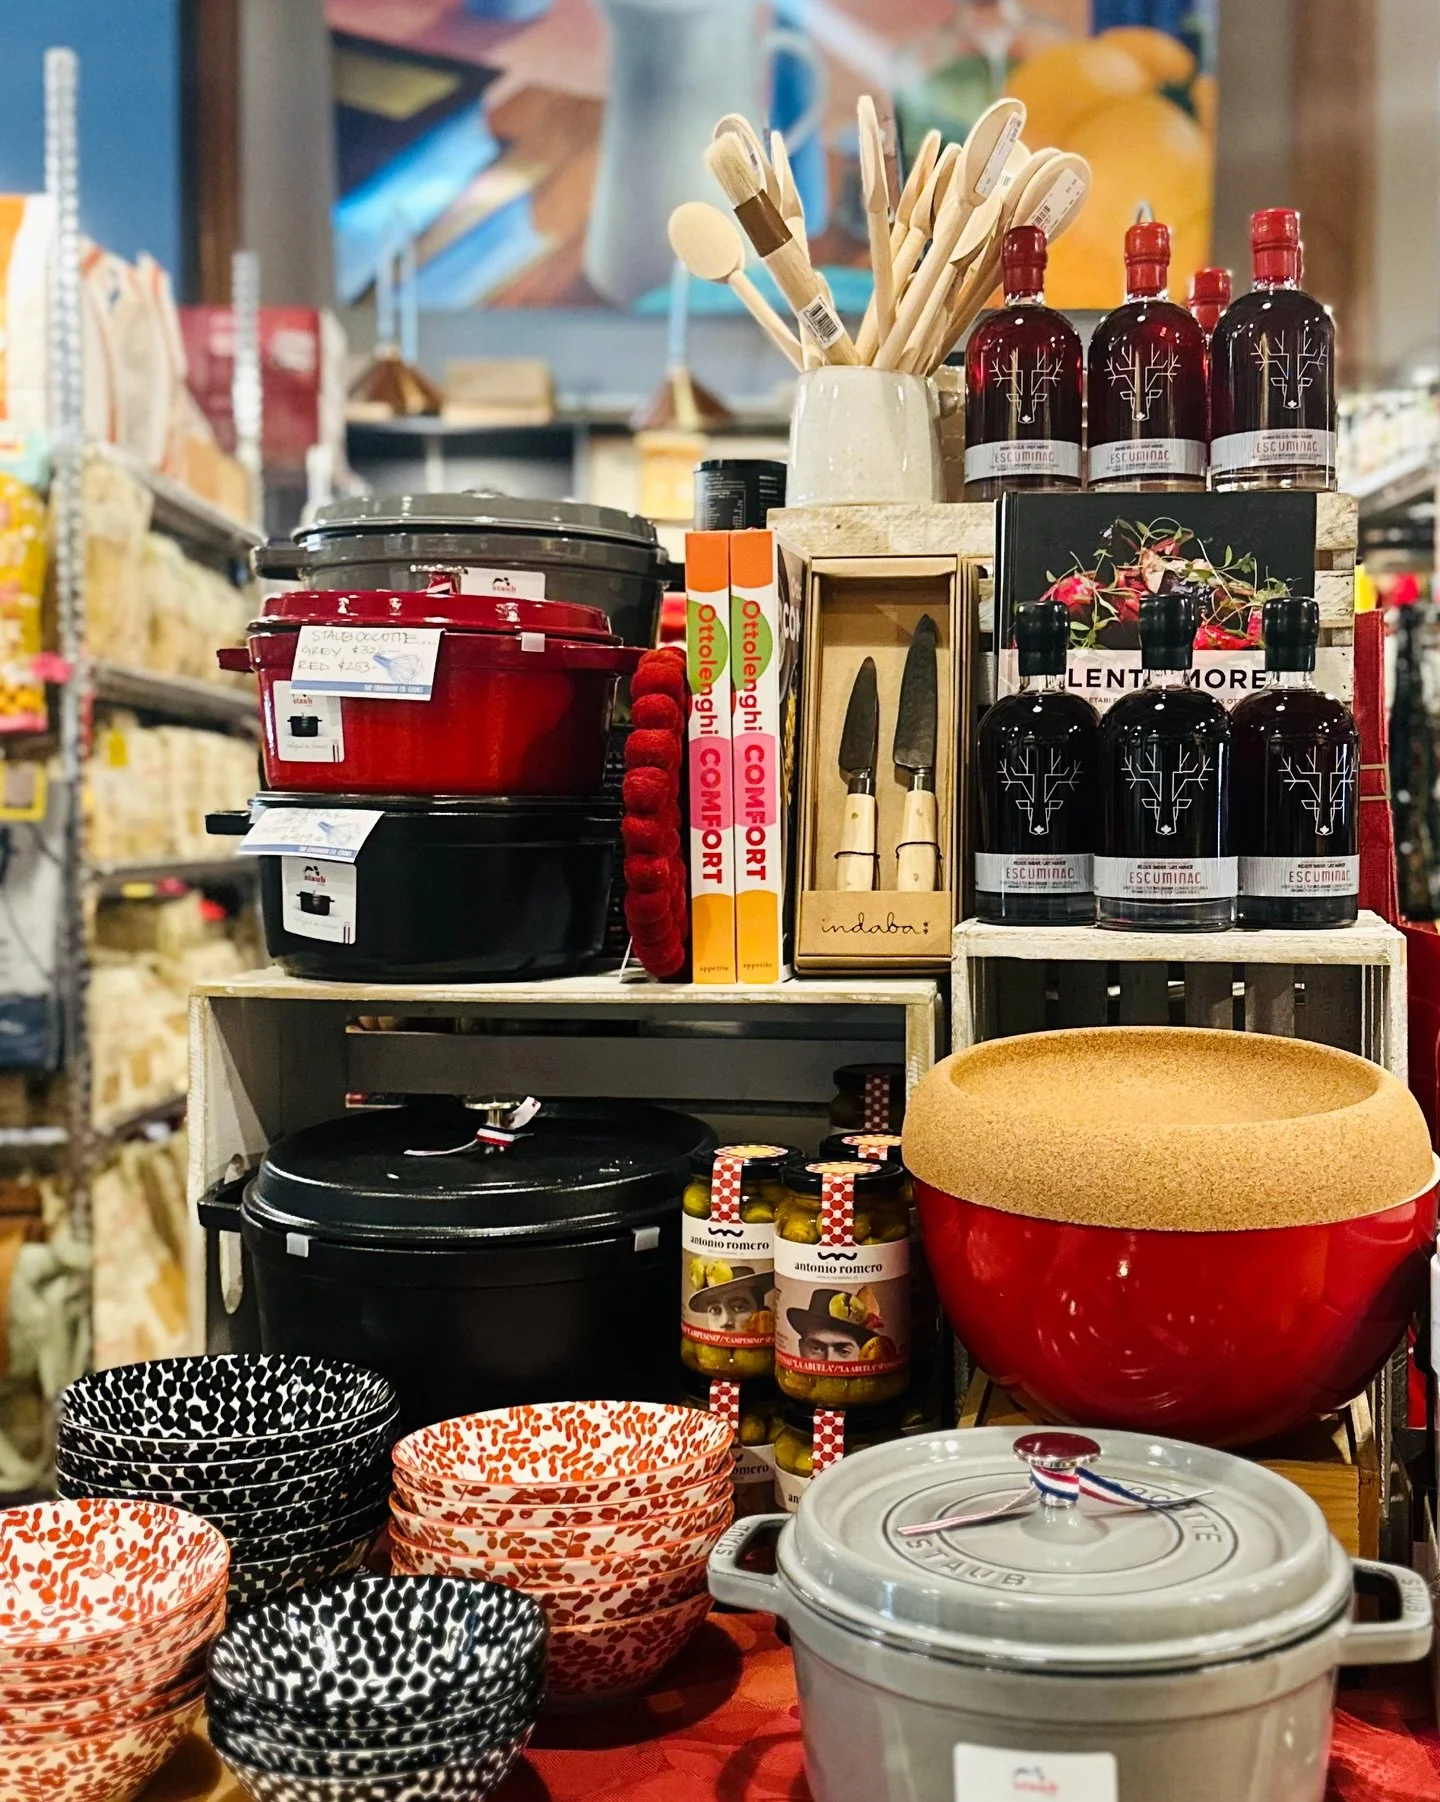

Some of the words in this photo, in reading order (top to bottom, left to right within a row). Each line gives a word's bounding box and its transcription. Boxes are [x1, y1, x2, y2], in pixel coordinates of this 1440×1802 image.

[695, 604, 718, 734] Ottolenghi
[739, 600, 763, 731] Ottolenghi
[1068, 668, 1143, 688] LENT
[700, 748, 722, 884] COMFORT
[744, 744, 766, 880] COMFORT
[1006, 867, 1074, 879] ESCUMINAC
[1129, 872, 1201, 884] ESCUMINAC
[690, 1236, 725, 1249] antonio
[726, 1241, 770, 1250] romero
[794, 1262, 837, 1274] antonio
[839, 1263, 883, 1274] romero
[732, 1464, 769, 1475] omero
[905, 1538, 1027, 1587] STAUB
